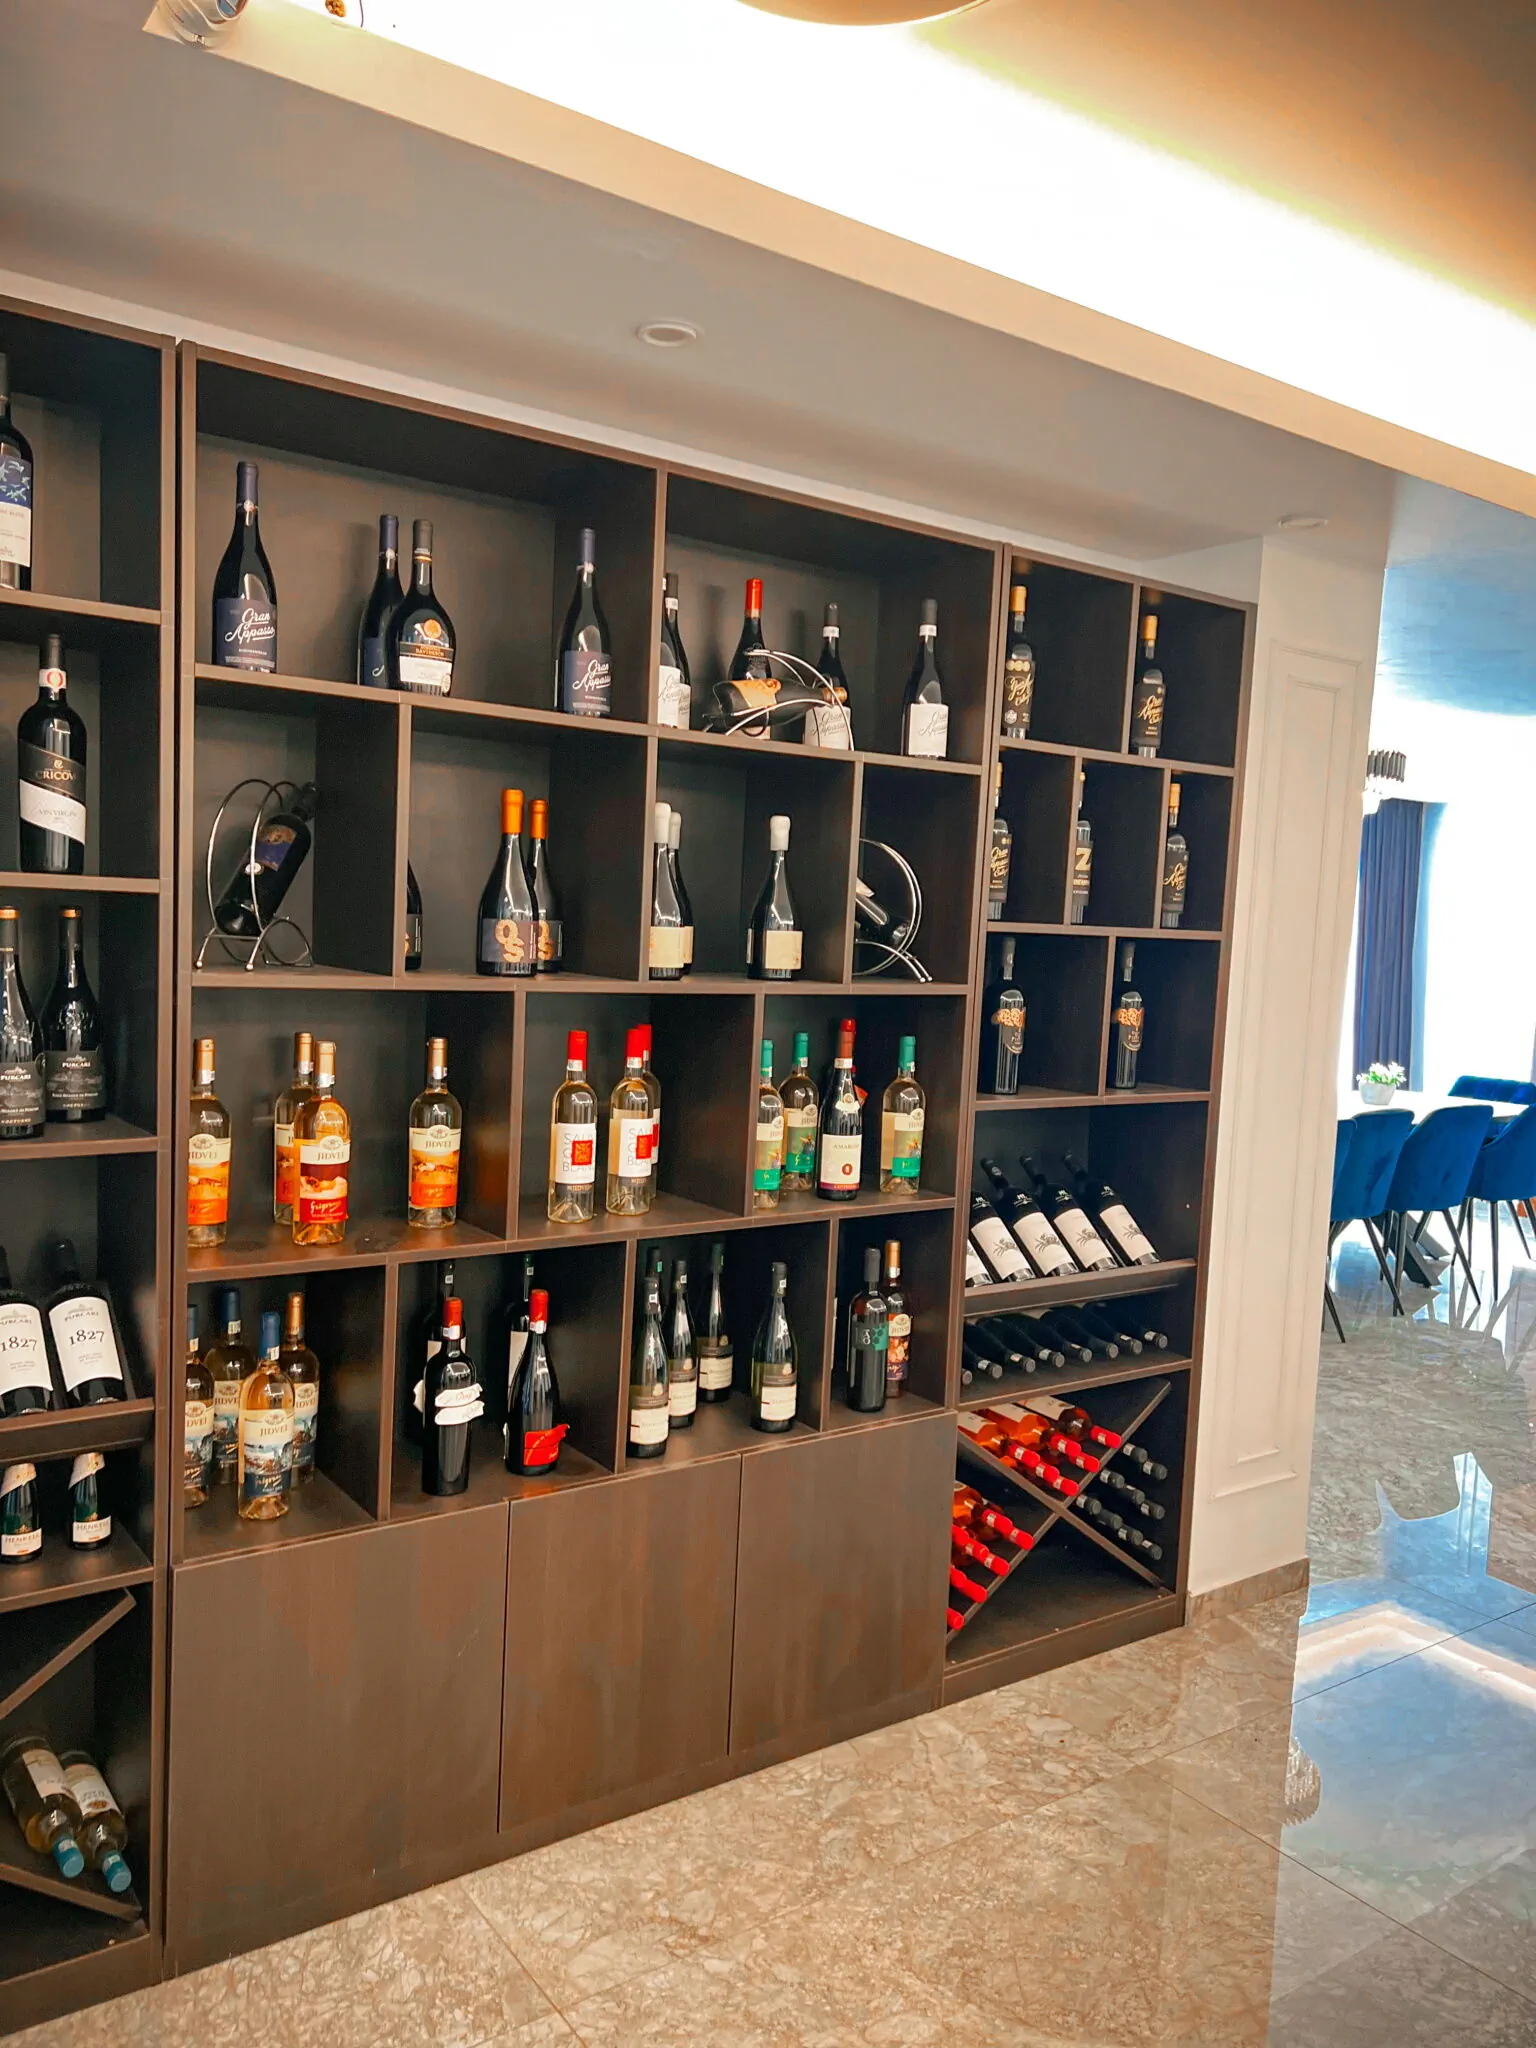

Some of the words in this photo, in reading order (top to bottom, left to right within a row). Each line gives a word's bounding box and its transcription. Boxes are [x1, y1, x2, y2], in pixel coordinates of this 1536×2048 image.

[241, 607, 271, 630] Gran
[35, 770, 76, 780] CRICOV
[1074, 847, 1092, 871] Z
[316, 1151, 344, 1161] JIDVEI
[0, 1335, 38, 1352] 1827
[68, 1328, 105, 1346] 1827
[294, 1398, 317, 1409] IDVEI
[260, 1424, 288, 1437] JIDVEI
